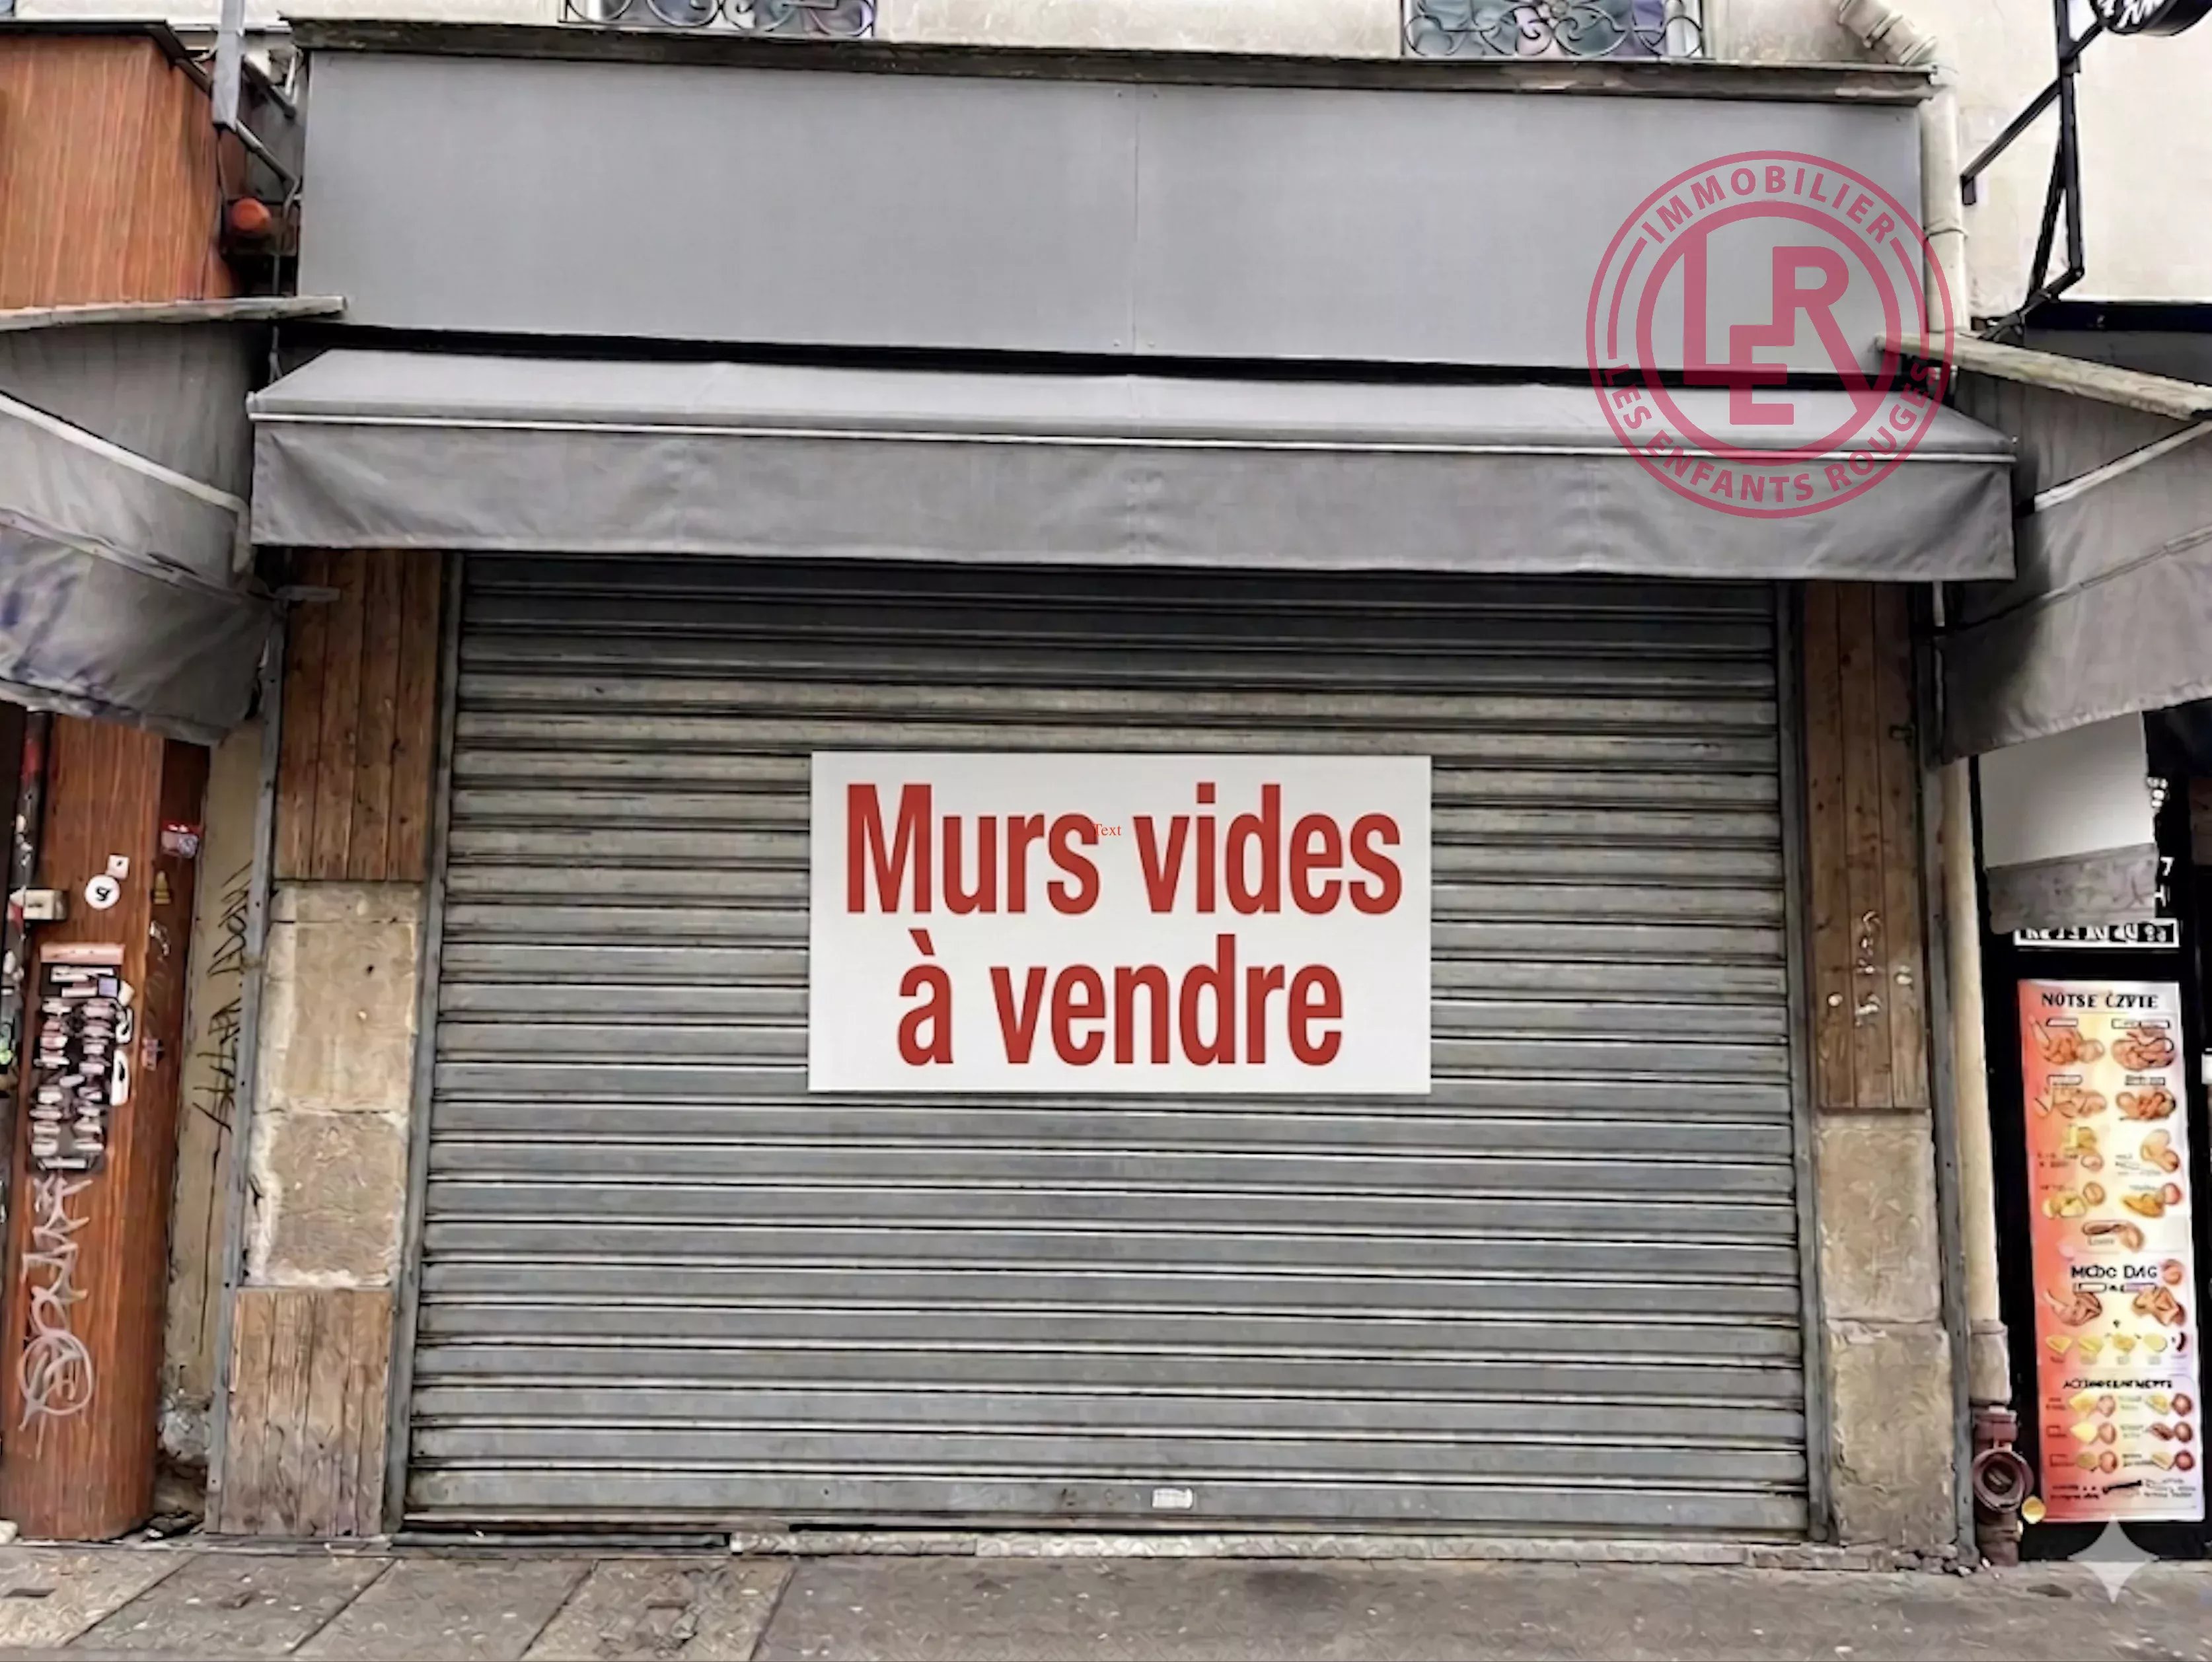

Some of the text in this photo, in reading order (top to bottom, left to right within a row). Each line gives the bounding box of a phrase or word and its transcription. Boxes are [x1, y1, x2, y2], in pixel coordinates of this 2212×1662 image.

[847, 782, 1402, 916] Murs vides
[897, 929, 1343, 1066] à vendre
